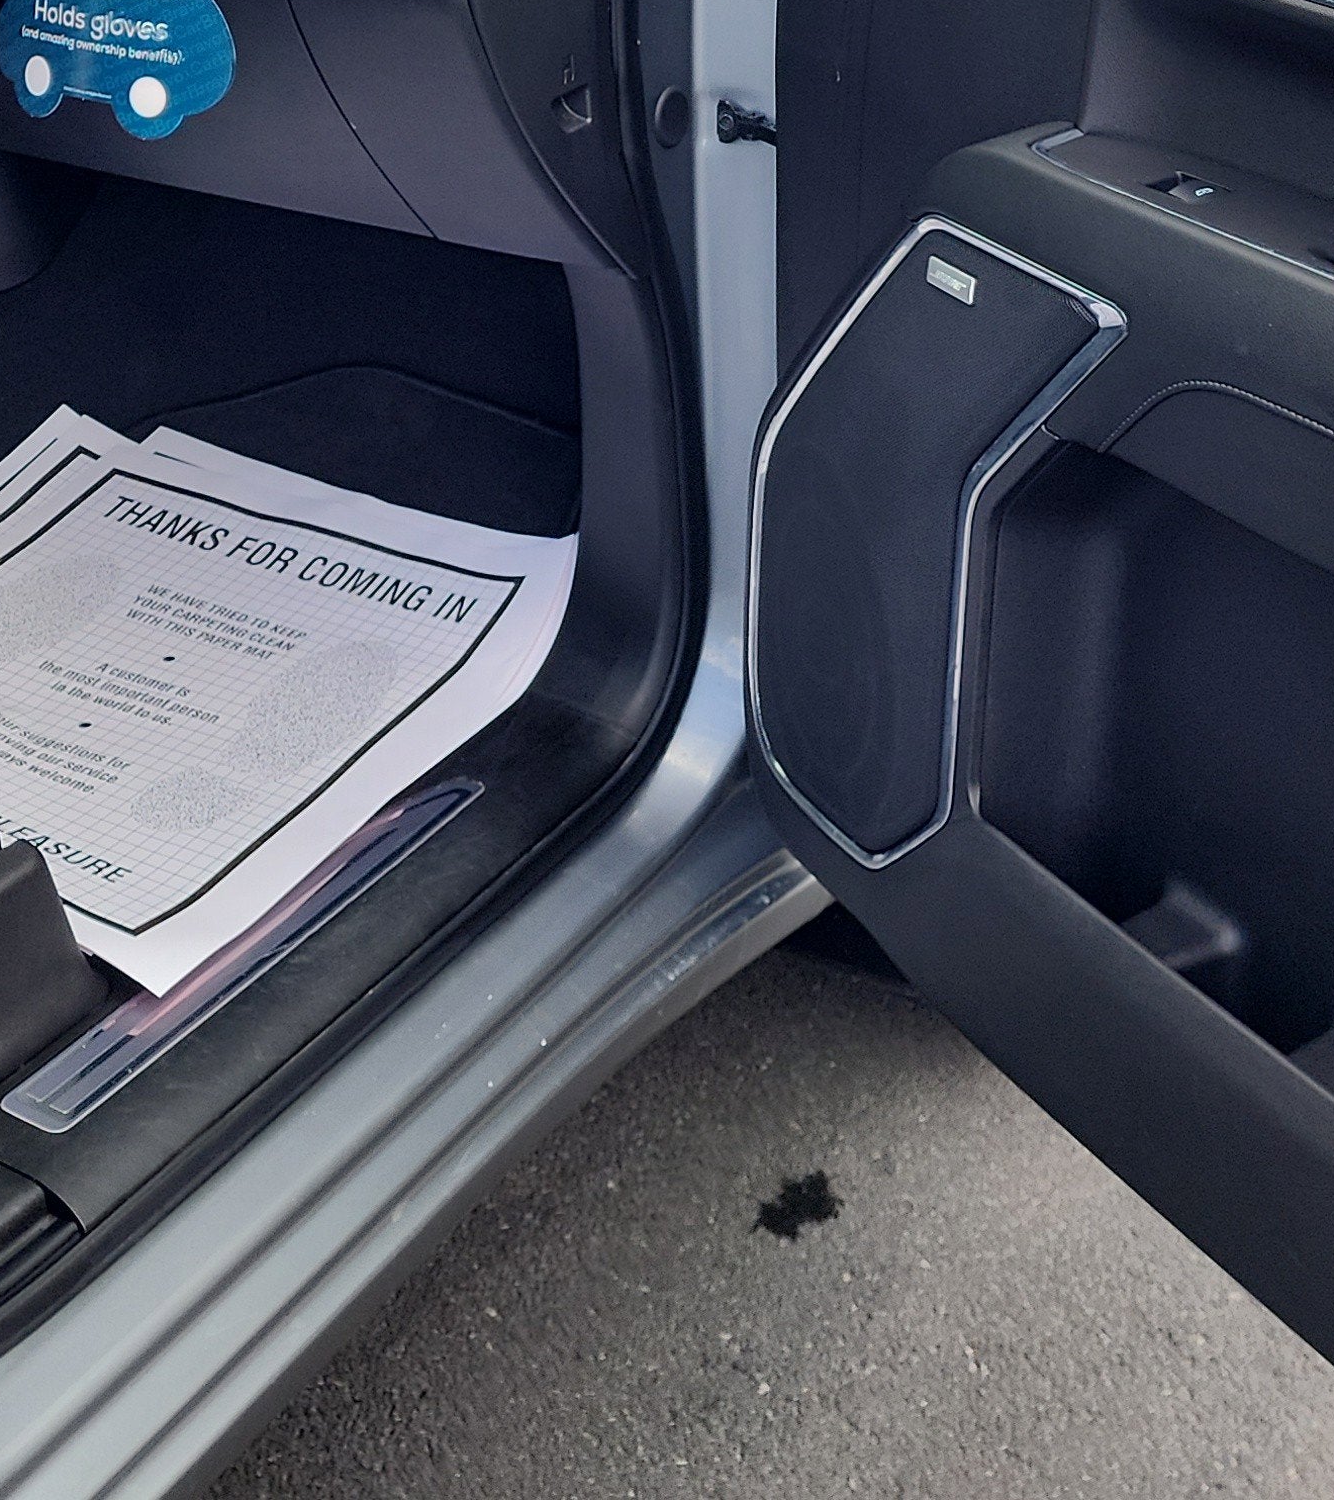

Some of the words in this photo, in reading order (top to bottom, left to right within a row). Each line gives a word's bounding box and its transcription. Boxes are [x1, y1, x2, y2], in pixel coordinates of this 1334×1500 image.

[39, 32, 76, 51] amazing
[76, 39, 127, 58] ownership
[90, 10, 169, 42] gloves
[103, 495, 230, 551] THANKS
[225, 536, 300, 574] FOR
[297, 555, 435, 612] COMING
[432, 592, 479, 624] IN
[133, 594, 173, 614] YOUR
[171, 608, 249, 638] CARPETING
[248, 632, 296, 651] CLEAN
[147, 583, 172, 597] WE
[169, 590, 208, 609] HAVE
[207, 604, 249, 624] TRIED
[249, 617, 271, 630] TO
[269, 623, 308, 640] KEEP
[125, 607, 164, 628] WITH
[164, 620, 198, 639] THIS
[195, 631, 244, 651] PAPER
[241, 646, 278, 660] MAT
[38, 659, 64, 675] the
[64, 669, 102, 688] most
[100, 680, 171, 709] important
[167, 701, 220, 725] person
[94, 662, 110, 674] A
[108, 666, 176, 694] customer
[67, 686, 93, 701] the
[92, 695, 137, 714] world
[134, 706, 152, 719] to
[151, 714, 173, 727] us.
[19, 728, 107, 763] suggestions
[106, 756, 132, 771] for
[35, 752, 66, 767] our
[62, 760, 120, 785] service
[27, 763, 97, 796] welcome.
